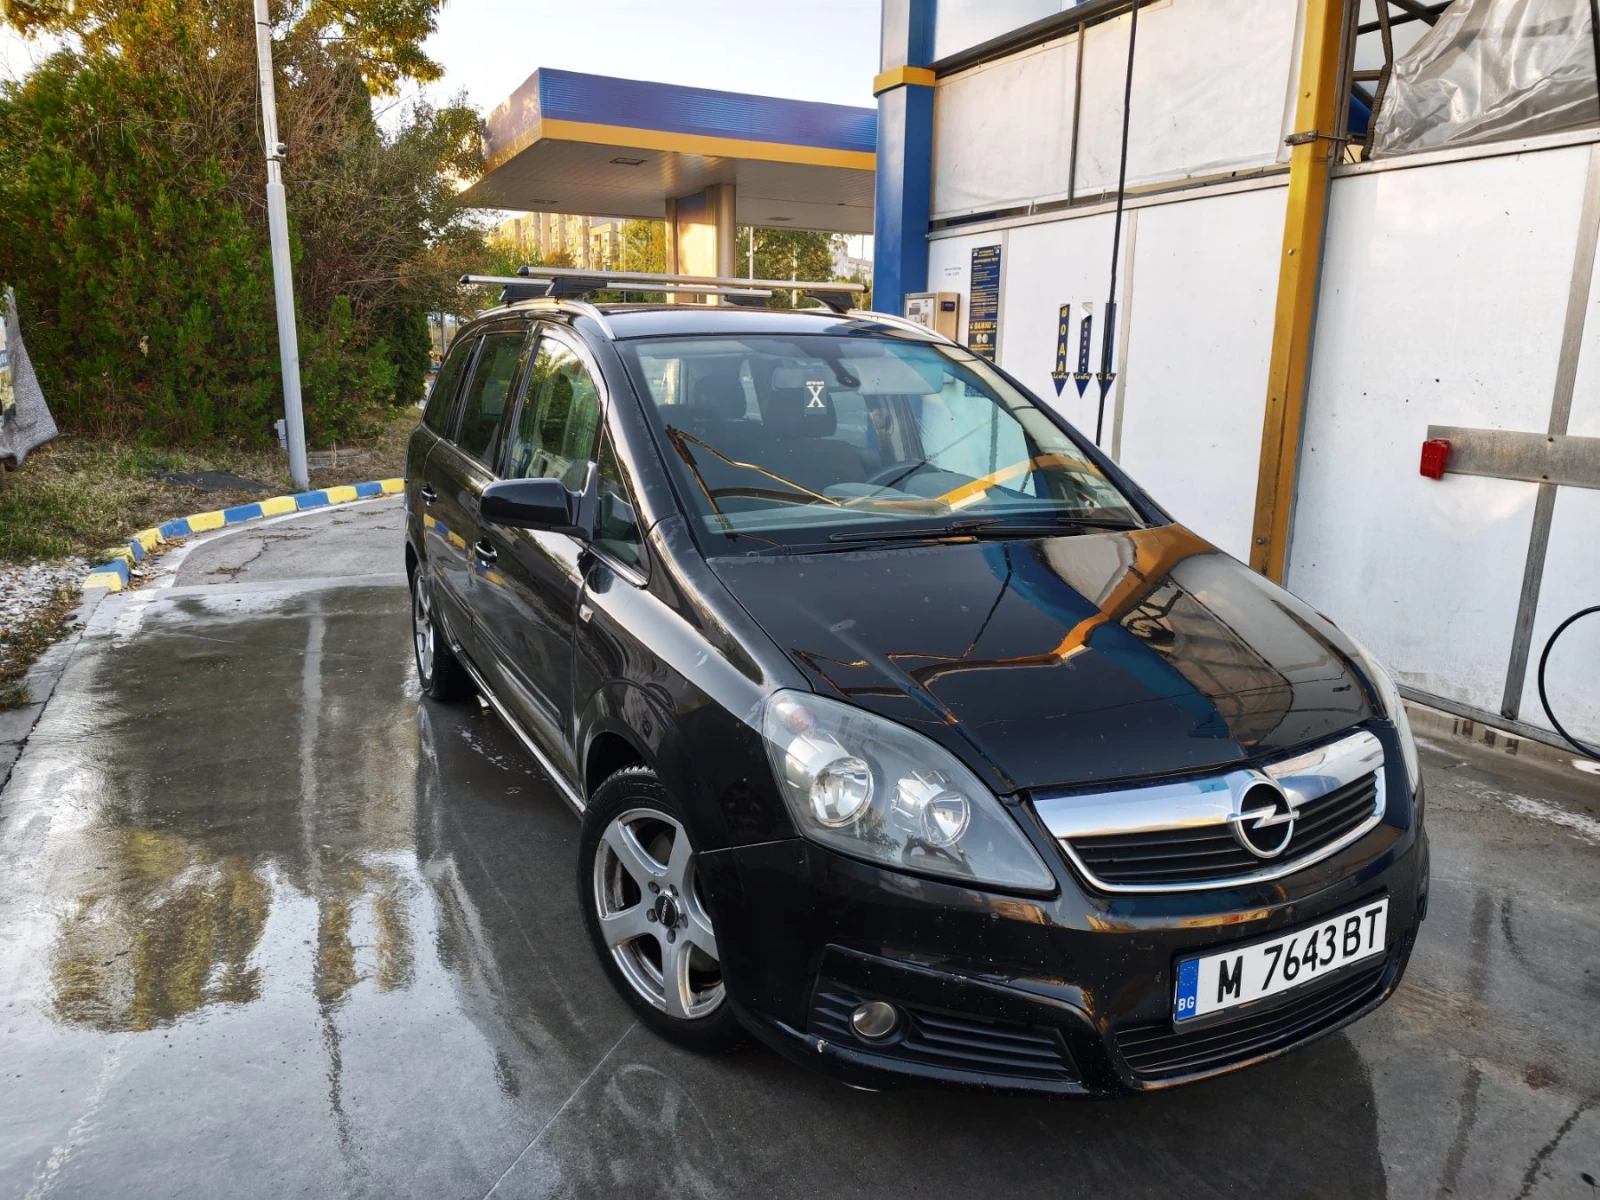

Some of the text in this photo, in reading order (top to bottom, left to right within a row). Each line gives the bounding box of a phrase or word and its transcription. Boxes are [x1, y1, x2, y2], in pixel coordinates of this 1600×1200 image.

[806, 386, 826, 408] X
[1217, 955, 1244, 1004] M
[1178, 996, 1195, 1012] BG
